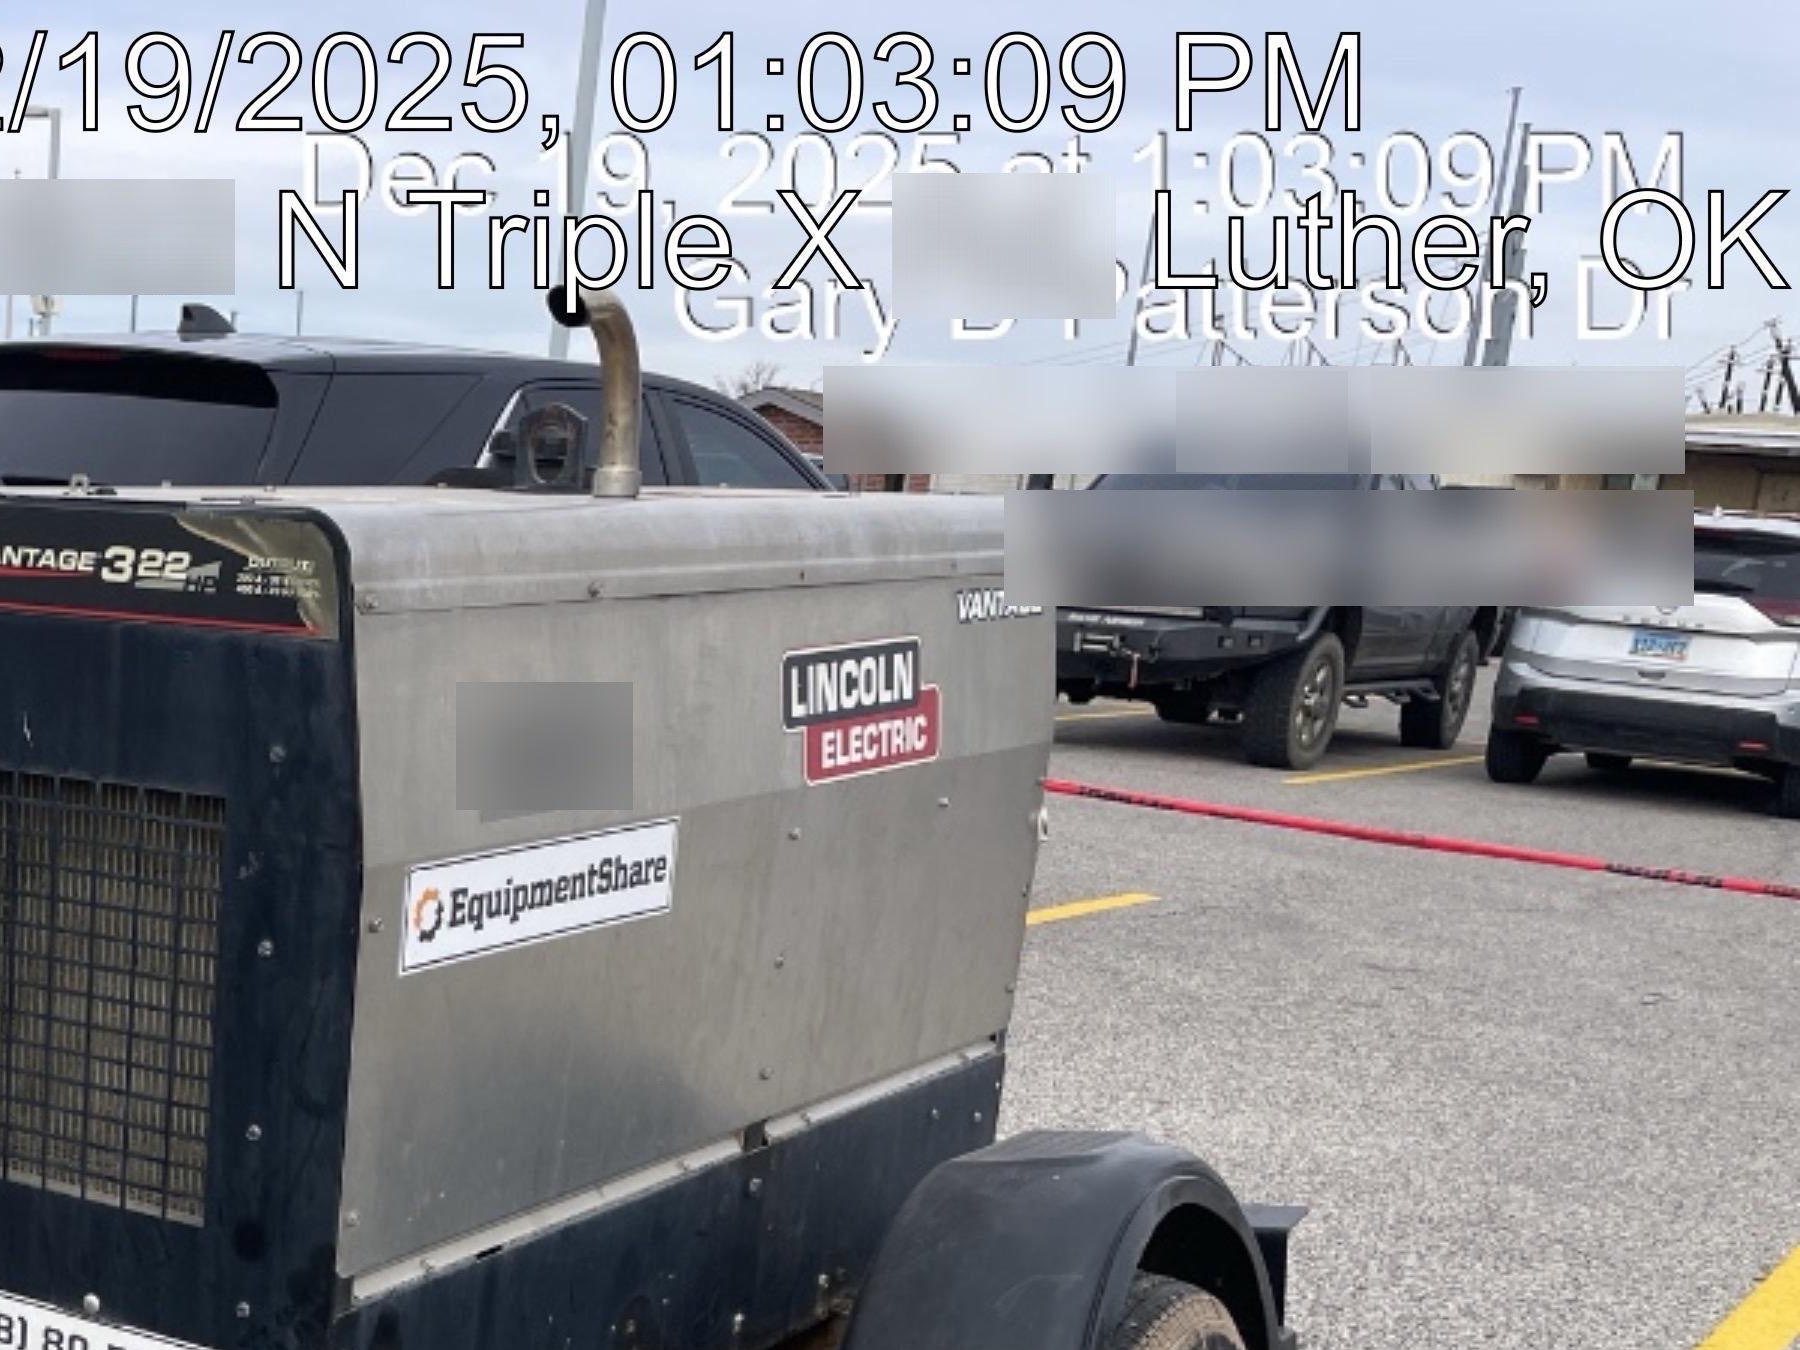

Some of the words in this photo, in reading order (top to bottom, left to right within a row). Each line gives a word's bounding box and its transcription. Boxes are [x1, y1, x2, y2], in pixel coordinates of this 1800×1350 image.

[100, 545, 191, 582] 322
[956, 589, 1043, 621] VANT
[790, 650, 914, 719] LINCOLN
[821, 715, 928, 769] ELECTRIC
[449, 855, 668, 931] EquipmentShare
